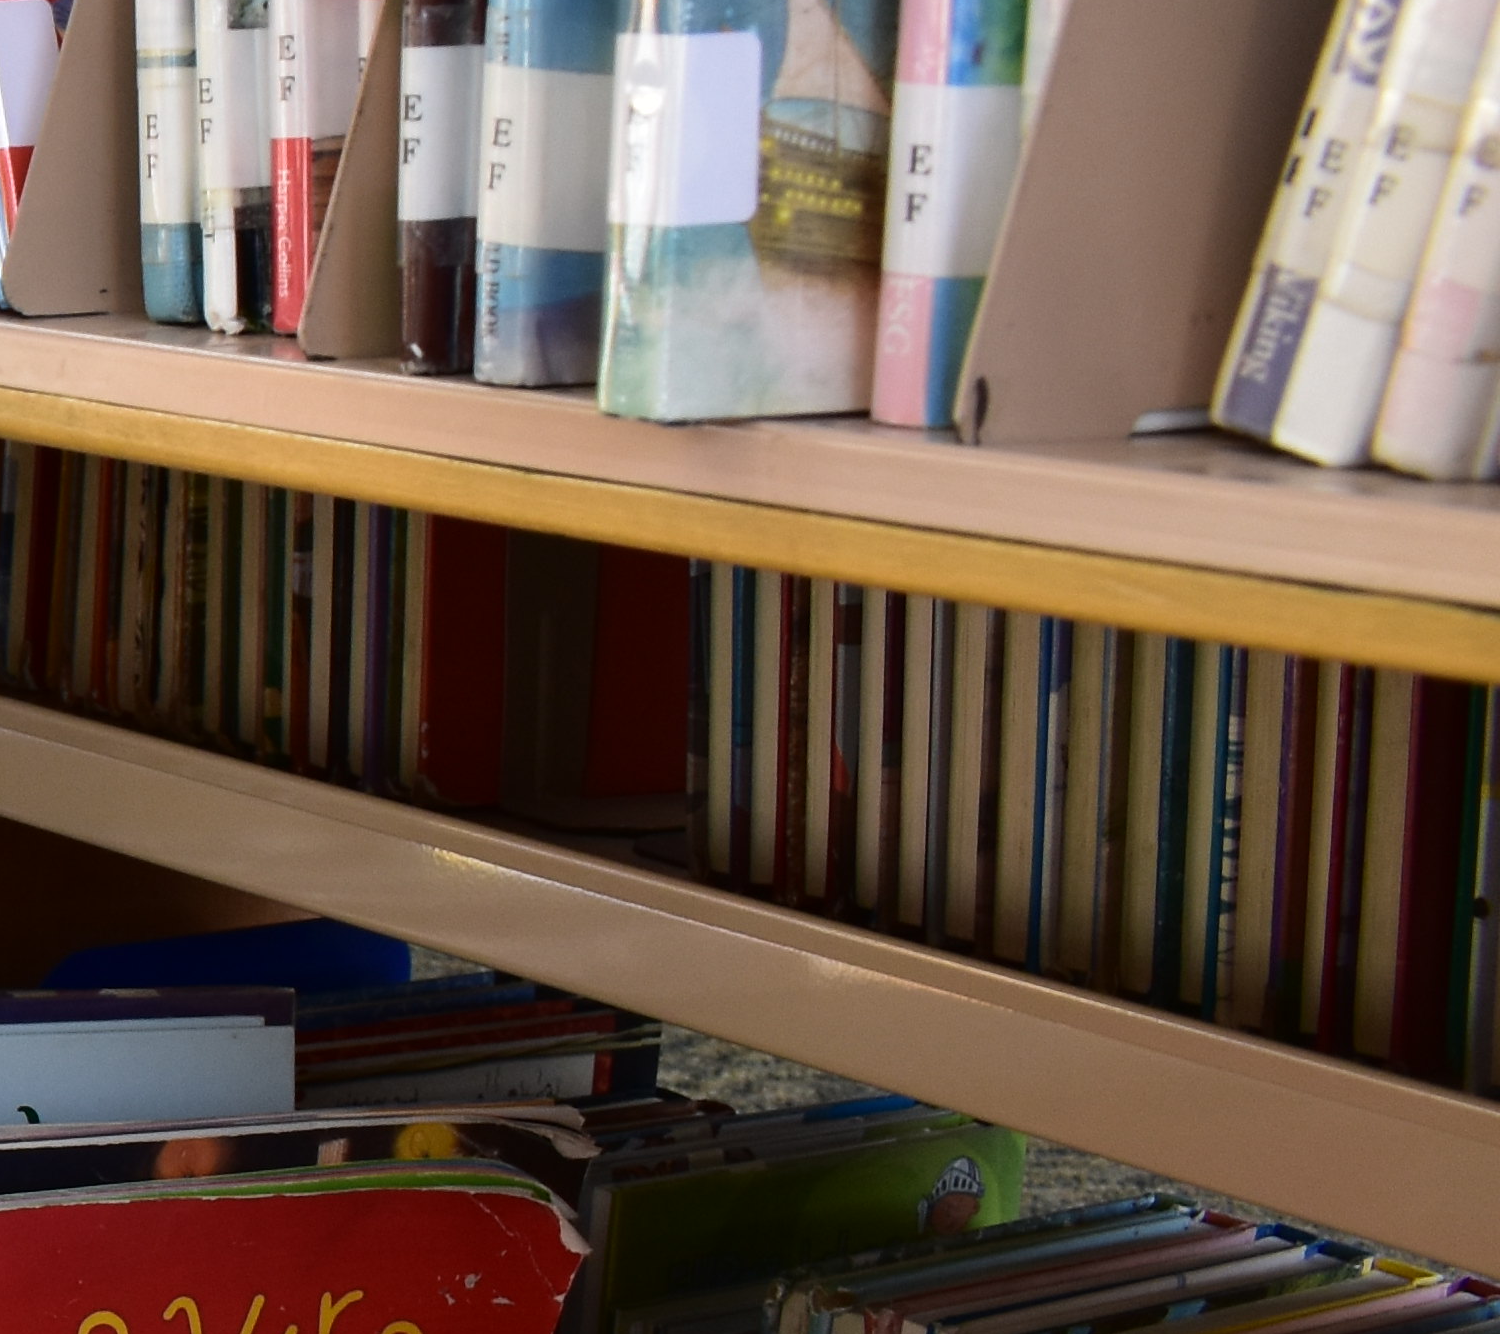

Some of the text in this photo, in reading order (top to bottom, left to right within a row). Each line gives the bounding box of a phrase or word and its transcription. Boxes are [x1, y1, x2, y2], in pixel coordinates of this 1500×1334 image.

[403, 93, 423, 122] E
[403, 137, 421, 165] F
[909, 144, 932, 175] E
[904, 193, 928, 223] F
